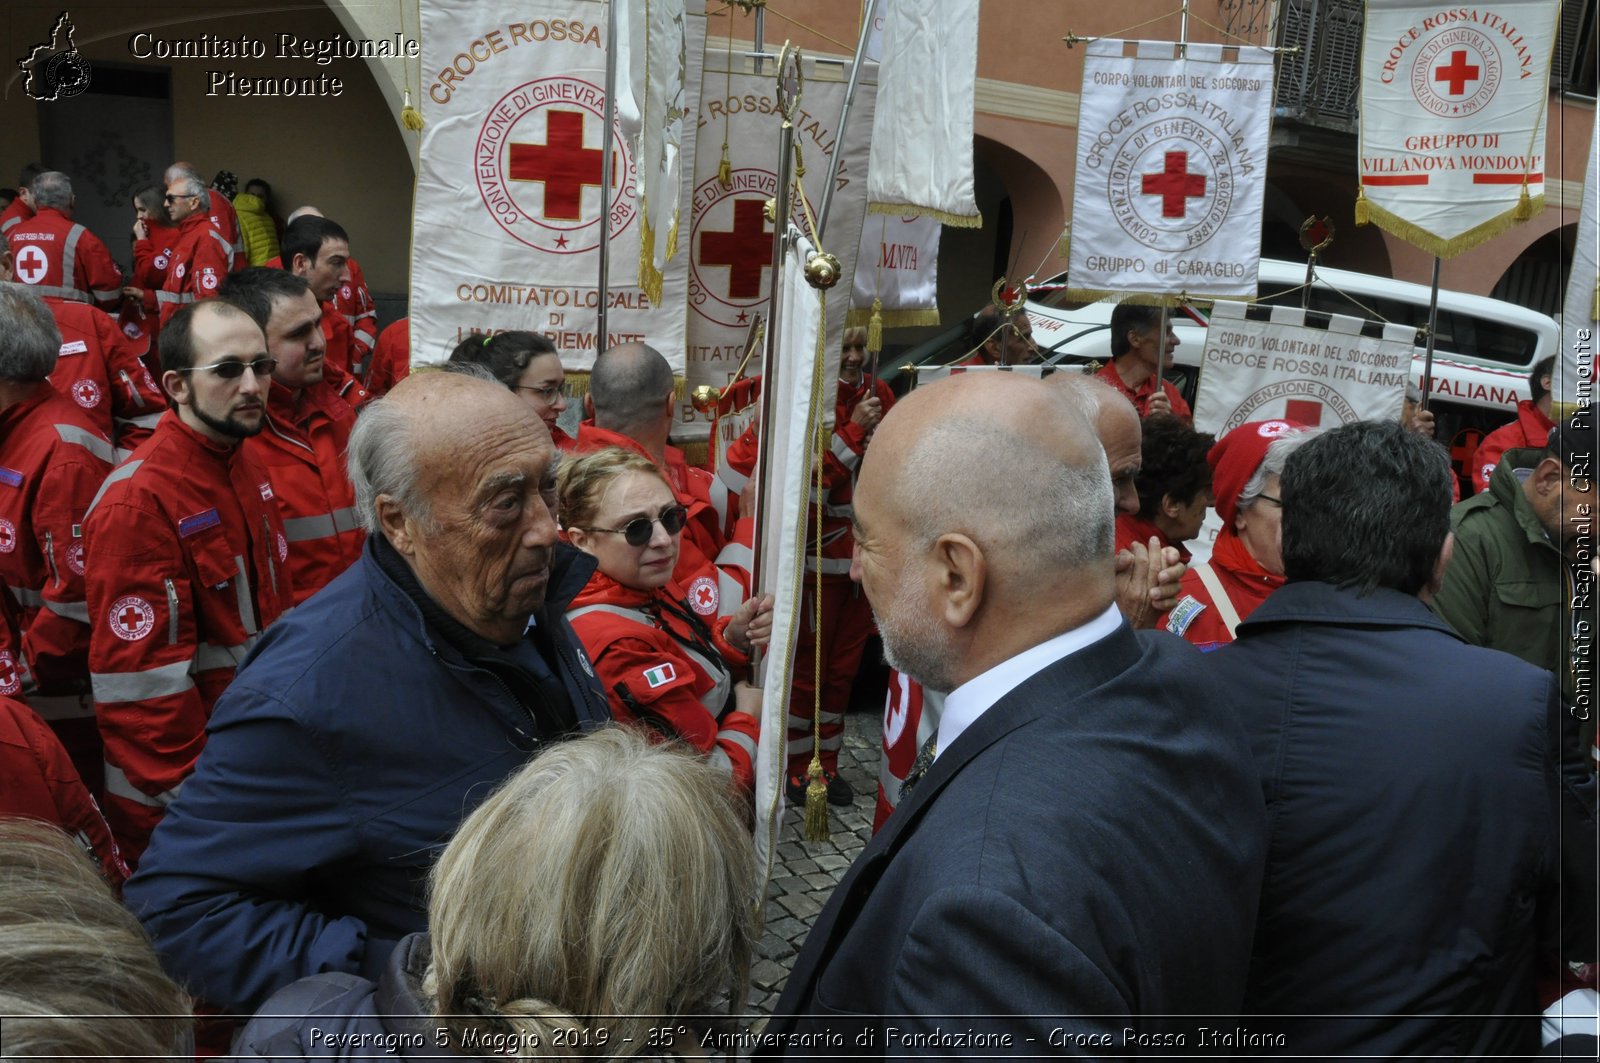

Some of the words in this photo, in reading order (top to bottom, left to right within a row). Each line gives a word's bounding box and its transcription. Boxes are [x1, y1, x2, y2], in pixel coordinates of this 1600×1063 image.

[1380, 26, 1423, 84] CROCE
[1422, 8, 1478, 32] ROSSA
[1482, 12, 1533, 80] ITALIANA
[1428, 40, 1442, 55] DI
[1441, 30, 1484, 50] GINEVRA
[1481, 46, 1495, 59] 22
[429, 30, 508, 105] CROCE
[509, 19, 602, 48] ROSSA
[1094, 71, 1129, 86] CORPO
[1132, 74, 1187, 88] VOLONTARI
[1190, 76, 1206, 89] DEL
[1211, 78, 1261, 92] SOCCORSO
[1415, 53, 1449, 114] CONVENZIONE
[1480, 59, 1498, 100] AGOSTO
[1462, 96, 1482, 113] 1864
[1086, 110, 1133, 169] CROCE
[1133, 92, 1198, 118] ROSSA
[1201, 100, 1255, 177] ITALIANA
[1133, 133, 1148, 149] DI
[1153, 121, 1213, 149] GINEVRA
[1405, 134, 1478, 151] GRUPPO
[1483, 134, 1499, 149] DI
[480, 104, 518, 225] CONVENZIONE
[512, 92, 531, 111] DI
[532, 83, 605, 112] GINEVRA
[1212, 150, 1226, 168] 22
[1362, 155, 1456, 172] VILLANOVA
[1459, 155, 1542, 171] MONDOVI'
[703, 183, 720, 201] DI
[723, 174, 776, 194] GINEVR
[1112, 150, 1158, 244] CONVENZIONE
[1210, 172, 1230, 223] AGOSTO
[1186, 220, 1213, 246] 1864
[1086, 256, 1145, 273] GRUPPO
[1154, 259, 1168, 274] di
[1177, 260, 1245, 278] CARAGLIO
[456, 284, 570, 307] COMITATO
[549, 312, 564, 327] DI
[1219, 331, 1256, 349] CORPO
[1261, 336, 1321, 356] VOLONTARI
[1324, 345, 1342, 361] DEL
[1346, 348, 1398, 368] SOCCORSO
[1207, 348, 1266, 370] CROCE
[1272, 358, 1329, 379] ROSSA
[1332, 364, 1405, 389] ITALIANA
[1419, 375, 1520, 405] ITALIANA
[1227, 382, 1315, 431] CONVENZIONE
[1319, 386, 1331, 399] DI
